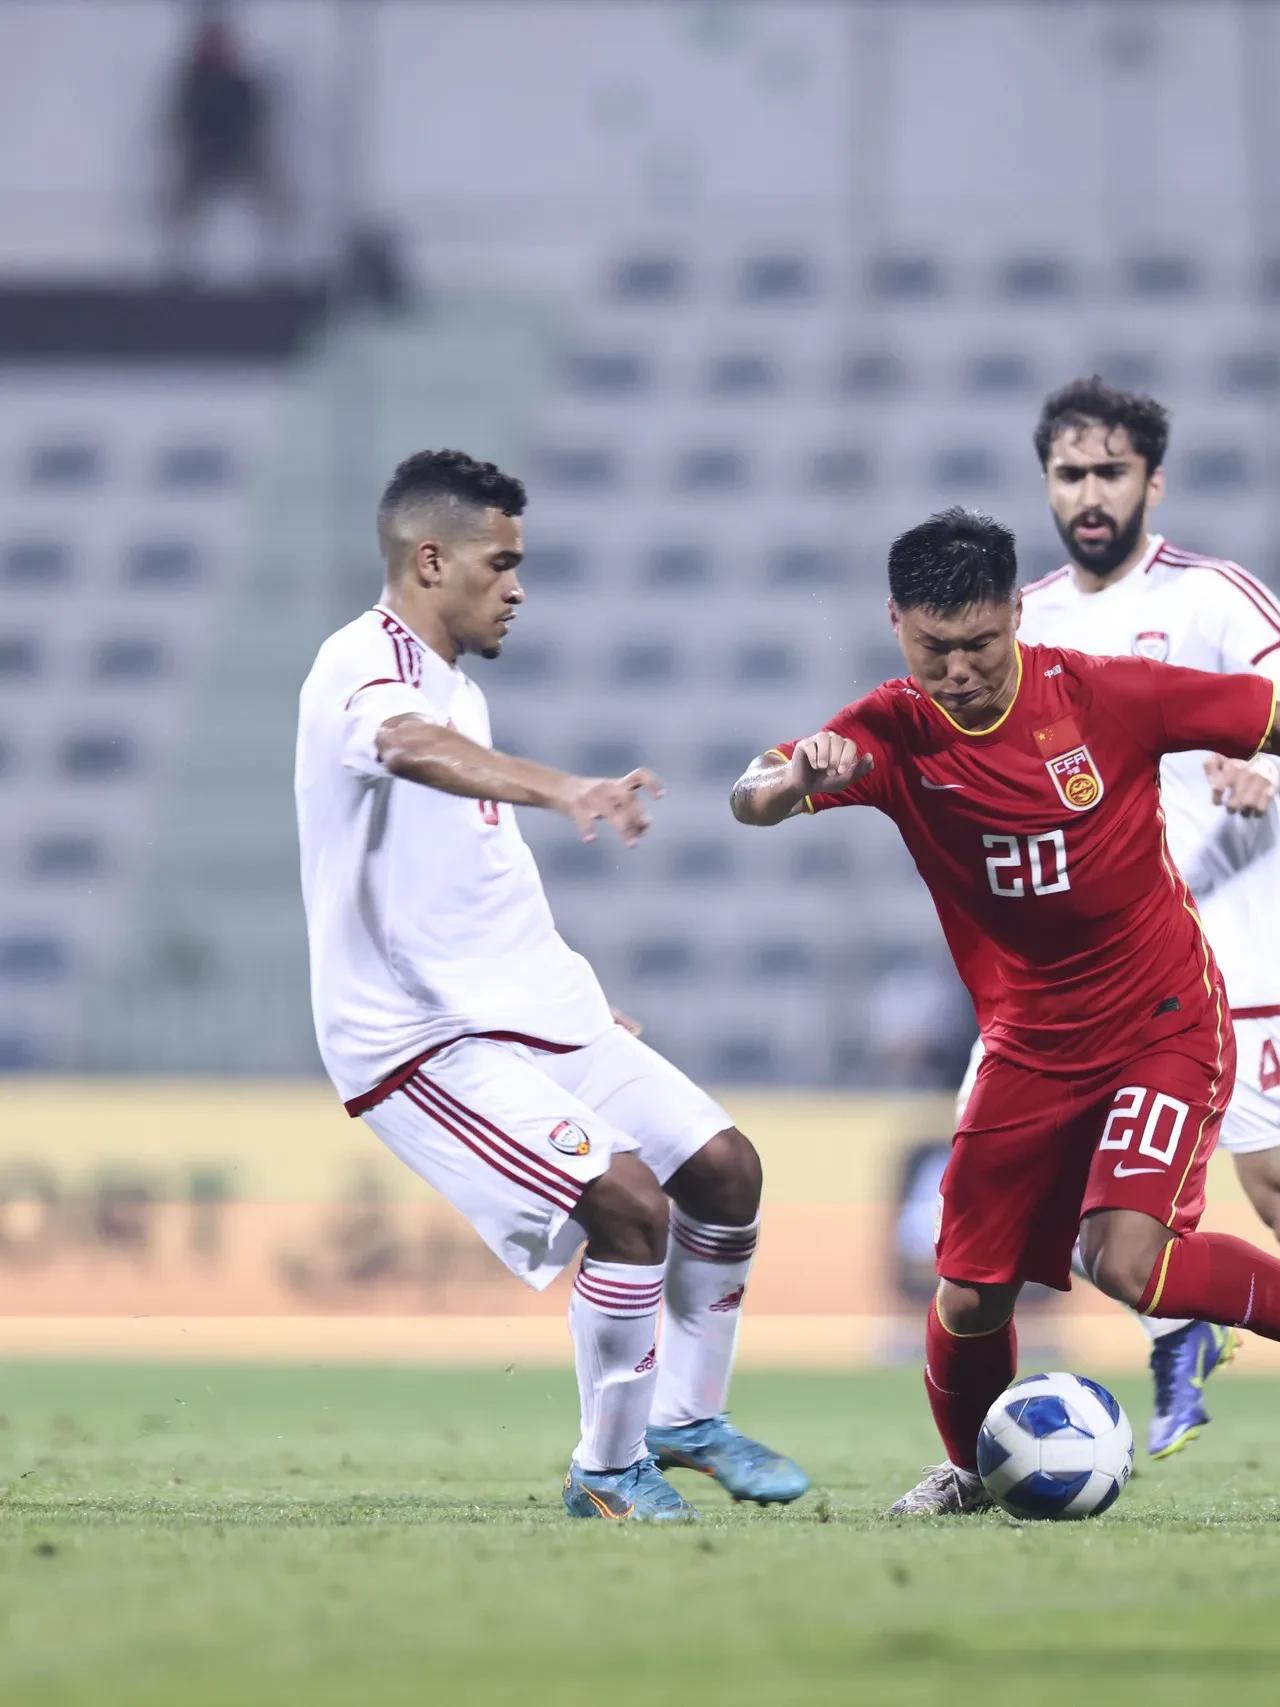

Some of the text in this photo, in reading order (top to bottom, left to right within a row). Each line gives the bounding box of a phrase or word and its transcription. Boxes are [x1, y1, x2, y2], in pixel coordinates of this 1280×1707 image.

[1053, 752, 1086, 774] CFA
[982, 829, 1071, 897] 20
[1099, 1086, 1190, 1166] 20
